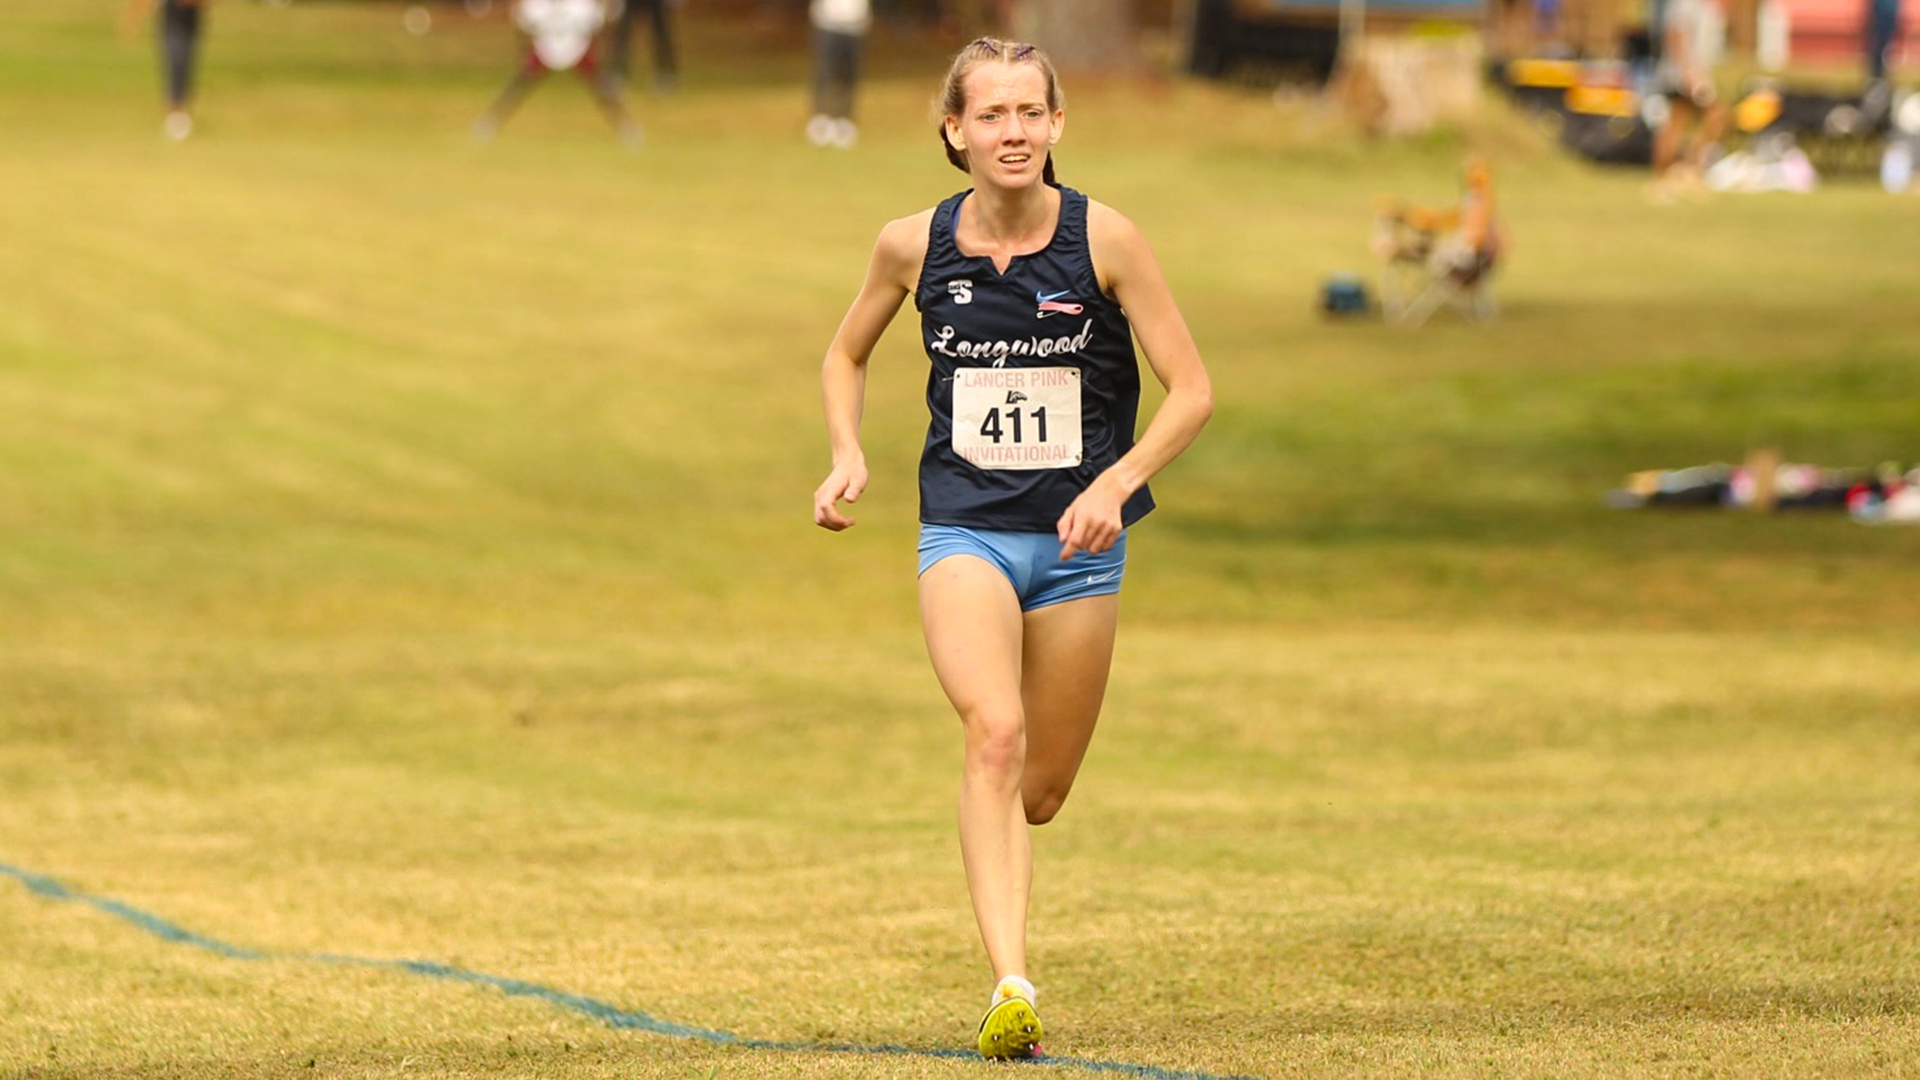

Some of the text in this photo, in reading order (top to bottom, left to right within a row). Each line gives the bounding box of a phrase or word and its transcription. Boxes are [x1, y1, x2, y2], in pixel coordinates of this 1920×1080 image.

[931, 319, 1093, 367] Longwood
[964, 371, 1069, 388] LANCER PINK
[980, 406, 1047, 443] 411
[964, 445, 1071, 462] INVITATIONAL
